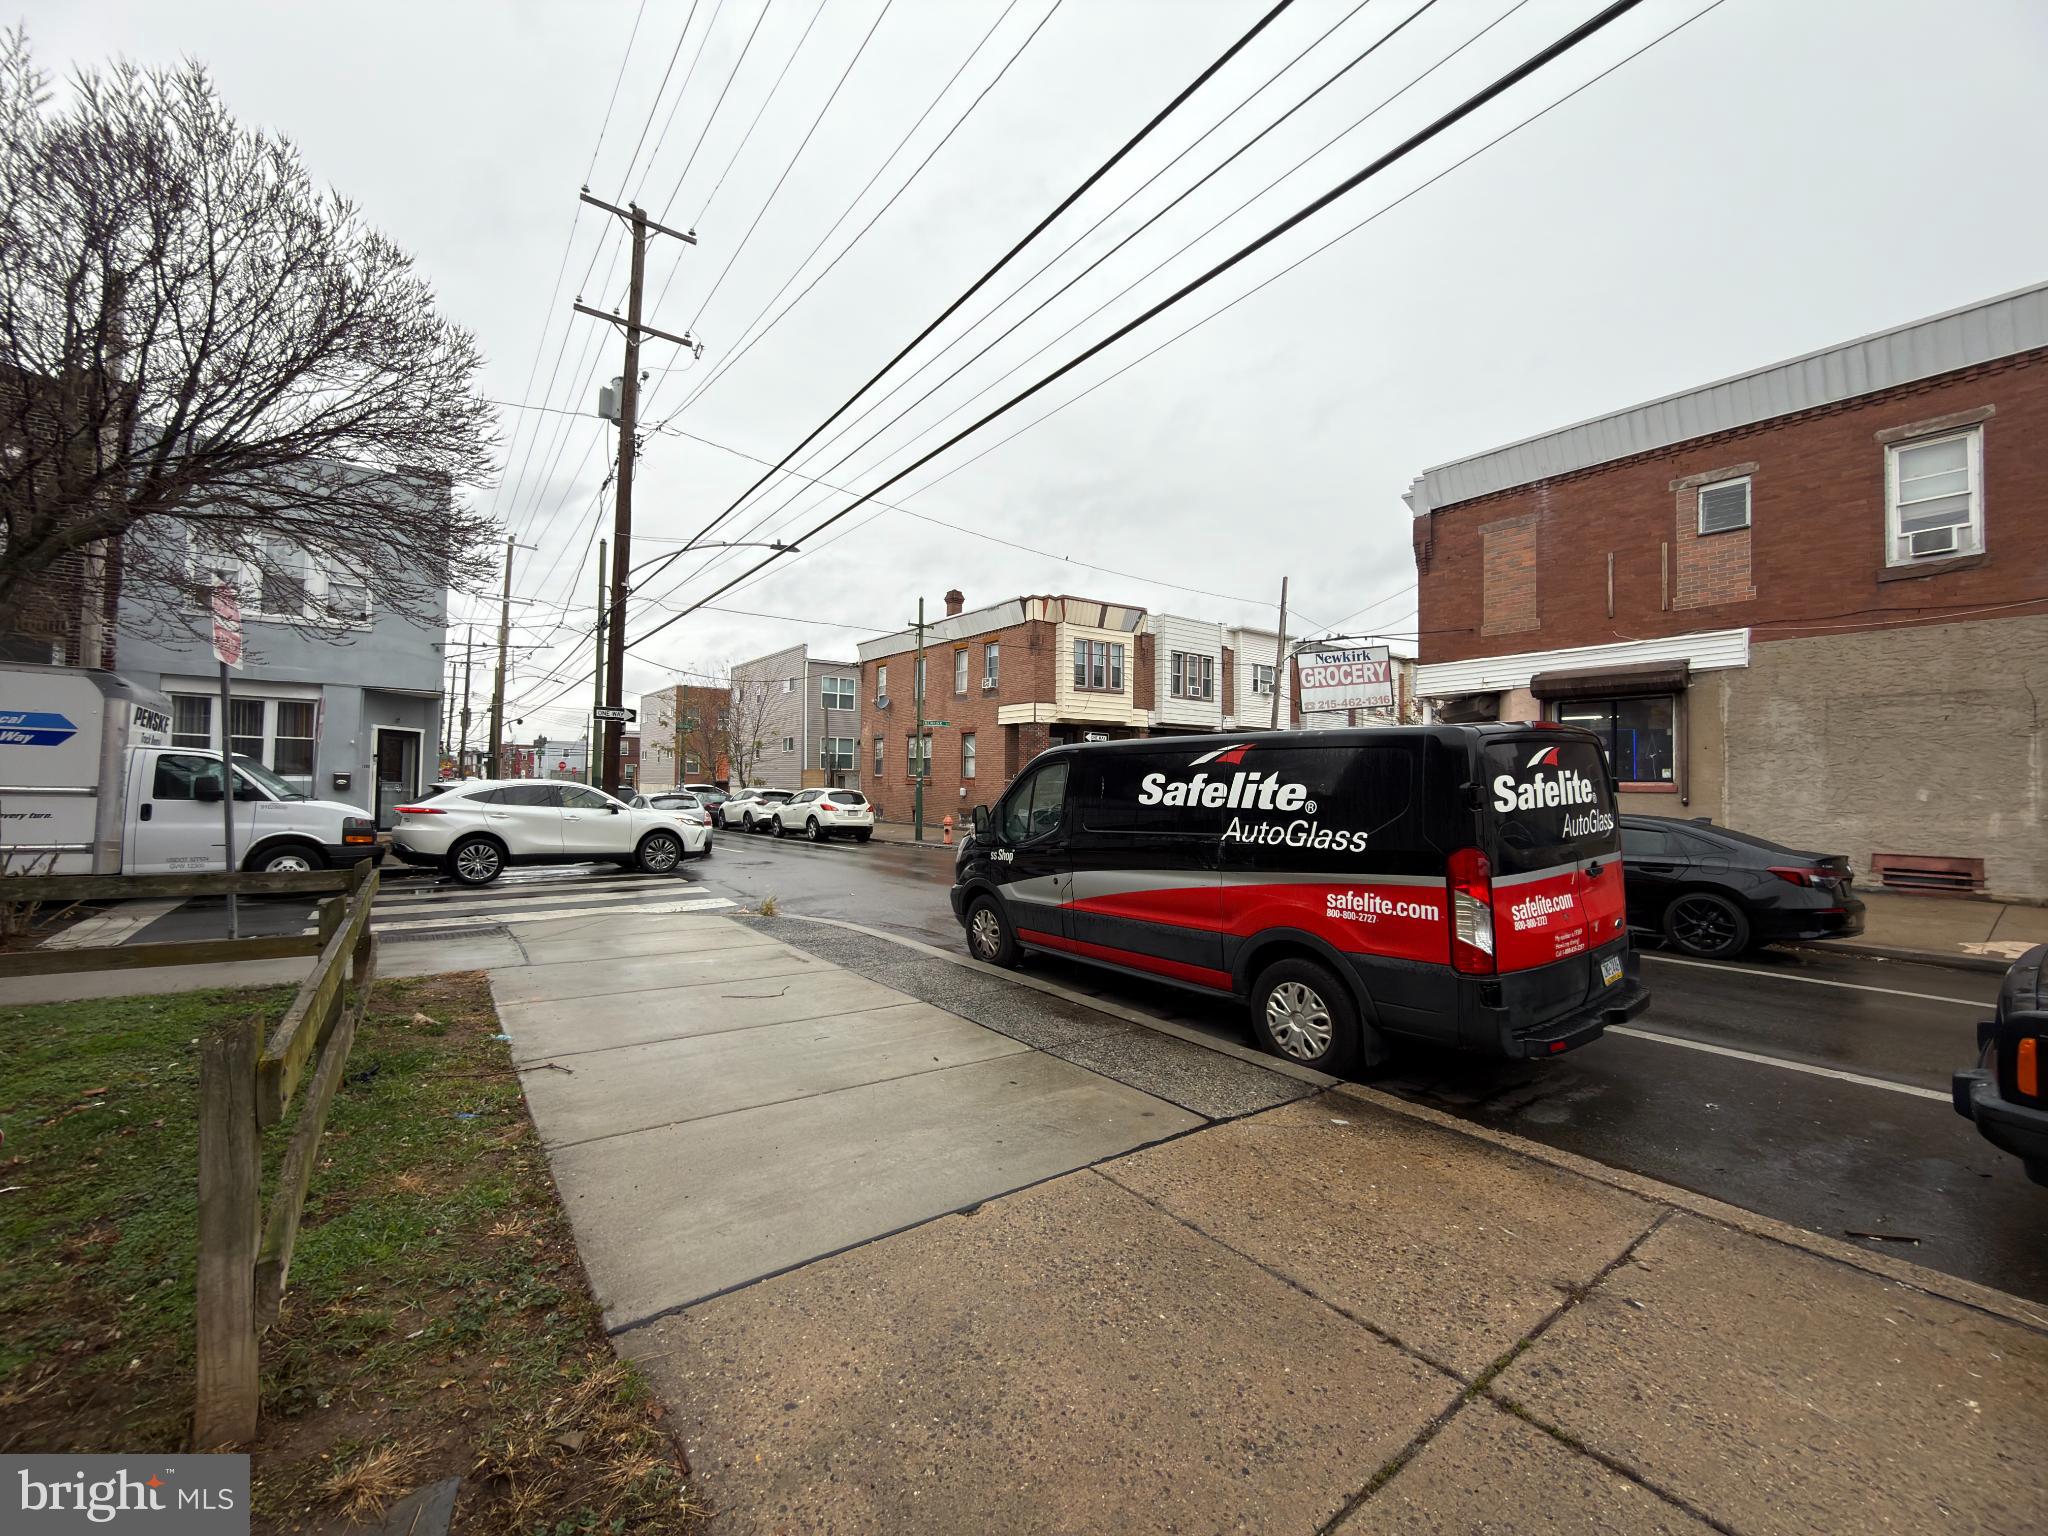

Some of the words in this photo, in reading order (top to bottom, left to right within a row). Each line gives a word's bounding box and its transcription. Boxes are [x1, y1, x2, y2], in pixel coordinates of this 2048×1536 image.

[1315, 650, 1372, 664] Newkirk
[1300, 662, 1387, 688] GROCERY
[1317, 695, 1391, 709] 215-462-1316
[133, 706, 170, 733] PENSKE
[1221, 816, 1369, 853] AutoGlass
[1562, 809, 1614, 839] AutoGlass
[1326, 891, 1439, 921] safelite.com
[1326, 908, 1377, 924] 800-800-2727
[1511, 893, 1574, 921] safelite.com
